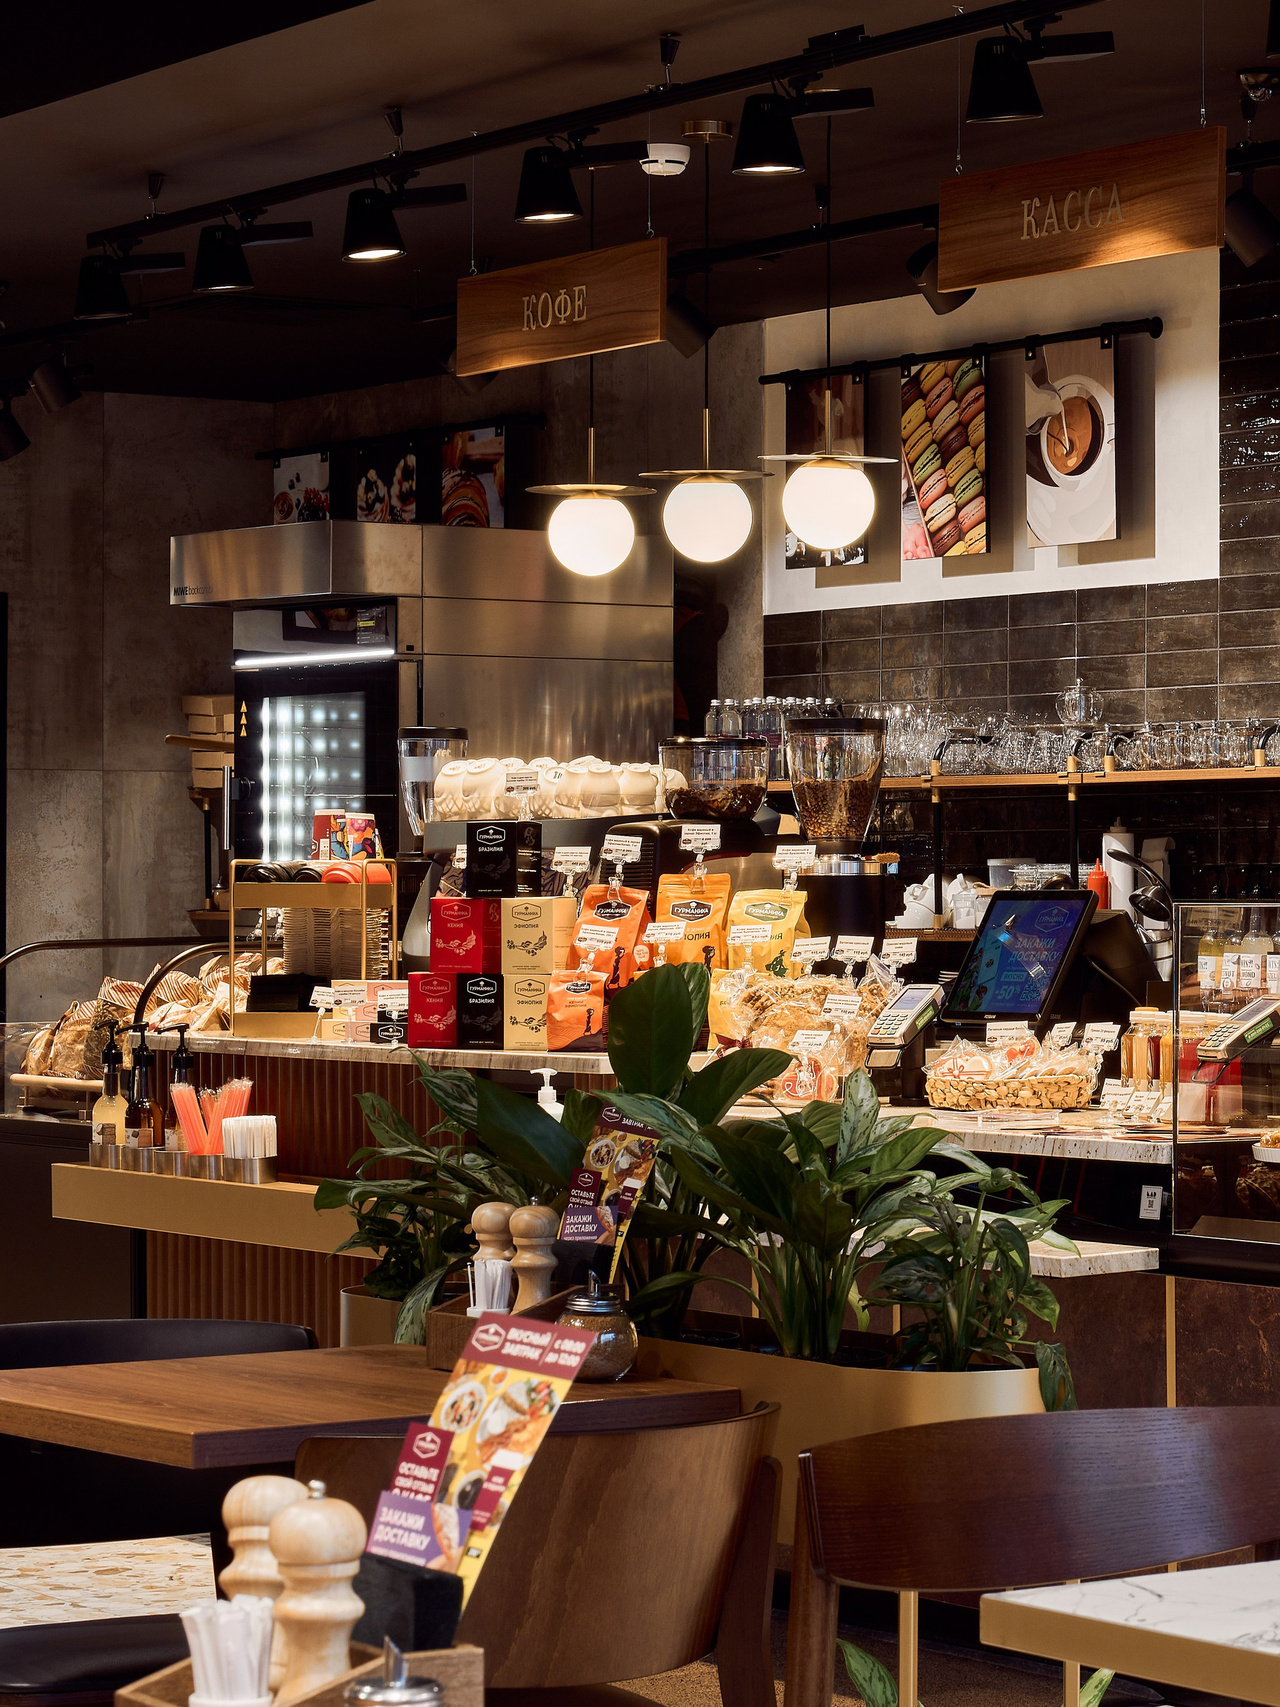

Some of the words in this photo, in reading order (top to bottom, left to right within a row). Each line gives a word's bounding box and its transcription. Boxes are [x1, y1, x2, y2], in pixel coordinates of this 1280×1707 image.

[1021, 184, 1125, 241] КАССА
[522, 284, 587, 331] КОФЕ
[674, 906, 708, 914] ГУРМАНИКА
[1015, 938, 1056, 948] ЗАКАЖИ
[1008, 951, 1061, 963] ДОСТАВКУ
[571, 1189, 595, 1199] ОСТАВЬТЕ
[566, 1215, 592, 1223] ЗАКАЖИ
[565, 1224, 597, 1234] ДОСТАВКУ
